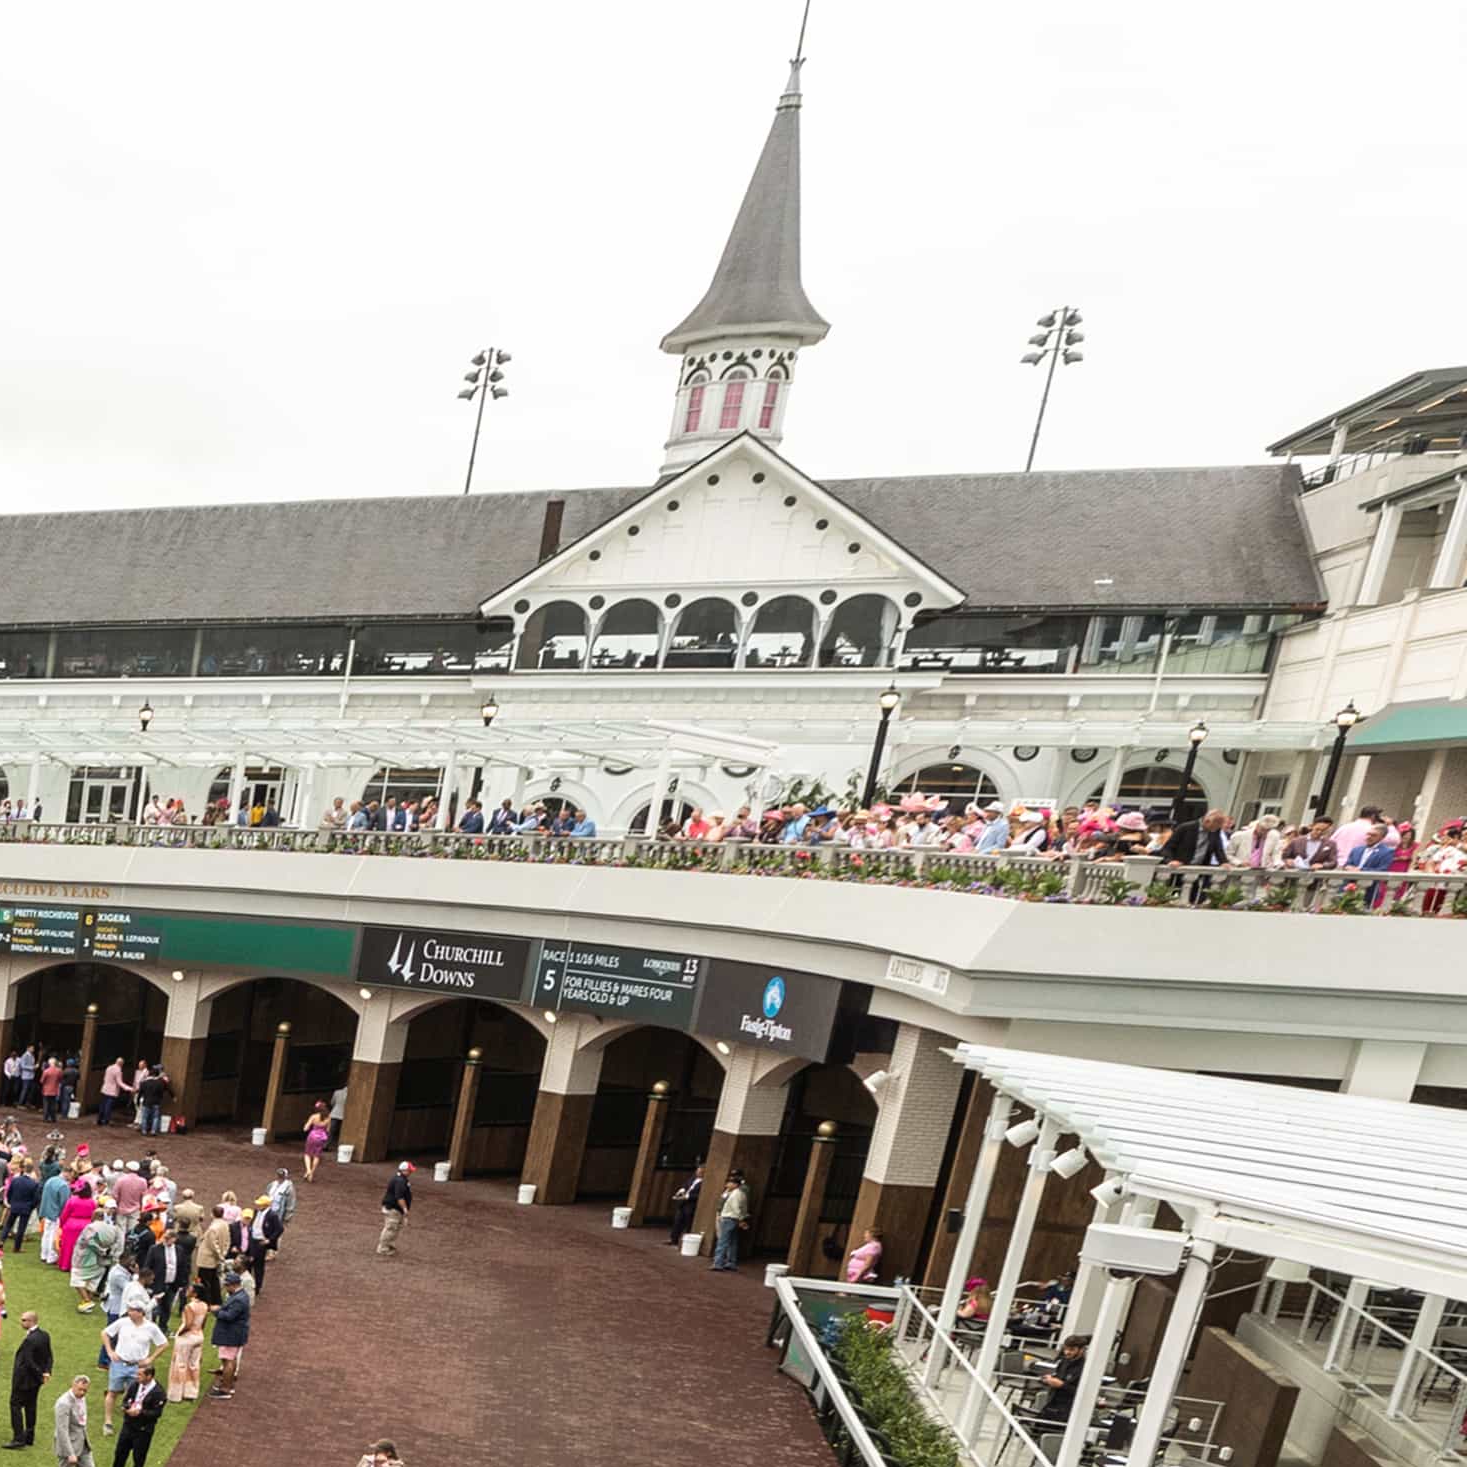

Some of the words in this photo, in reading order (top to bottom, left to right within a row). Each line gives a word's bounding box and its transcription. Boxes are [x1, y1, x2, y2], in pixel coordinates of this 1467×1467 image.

[61, 884, 110, 898] YEARS
[2, 910, 10, 920] 5
[85, 914, 93, 925] 6
[97, 912, 131, 923] XIGERA
[423, 939, 505, 966] CHURCHILL
[542, 949, 566, 963] RACE
[594, 955, 620, 969] MILES
[683, 958, 698, 974] 13
[419, 963, 476, 988] DOWNS
[543, 969, 557, 990] 5
[564, 976, 582, 987] FOR
[583, 978, 612, 993] FILLIES
[621, 983, 649, 999] MARES
[649, 987, 673, 1001] FOUR
[563, 988, 589, 1001] YEARS
[589, 992, 608, 1005] OLD
[617, 995, 630, 1007] UP
[740, 1014, 792, 1041] Fasig-Tipton
